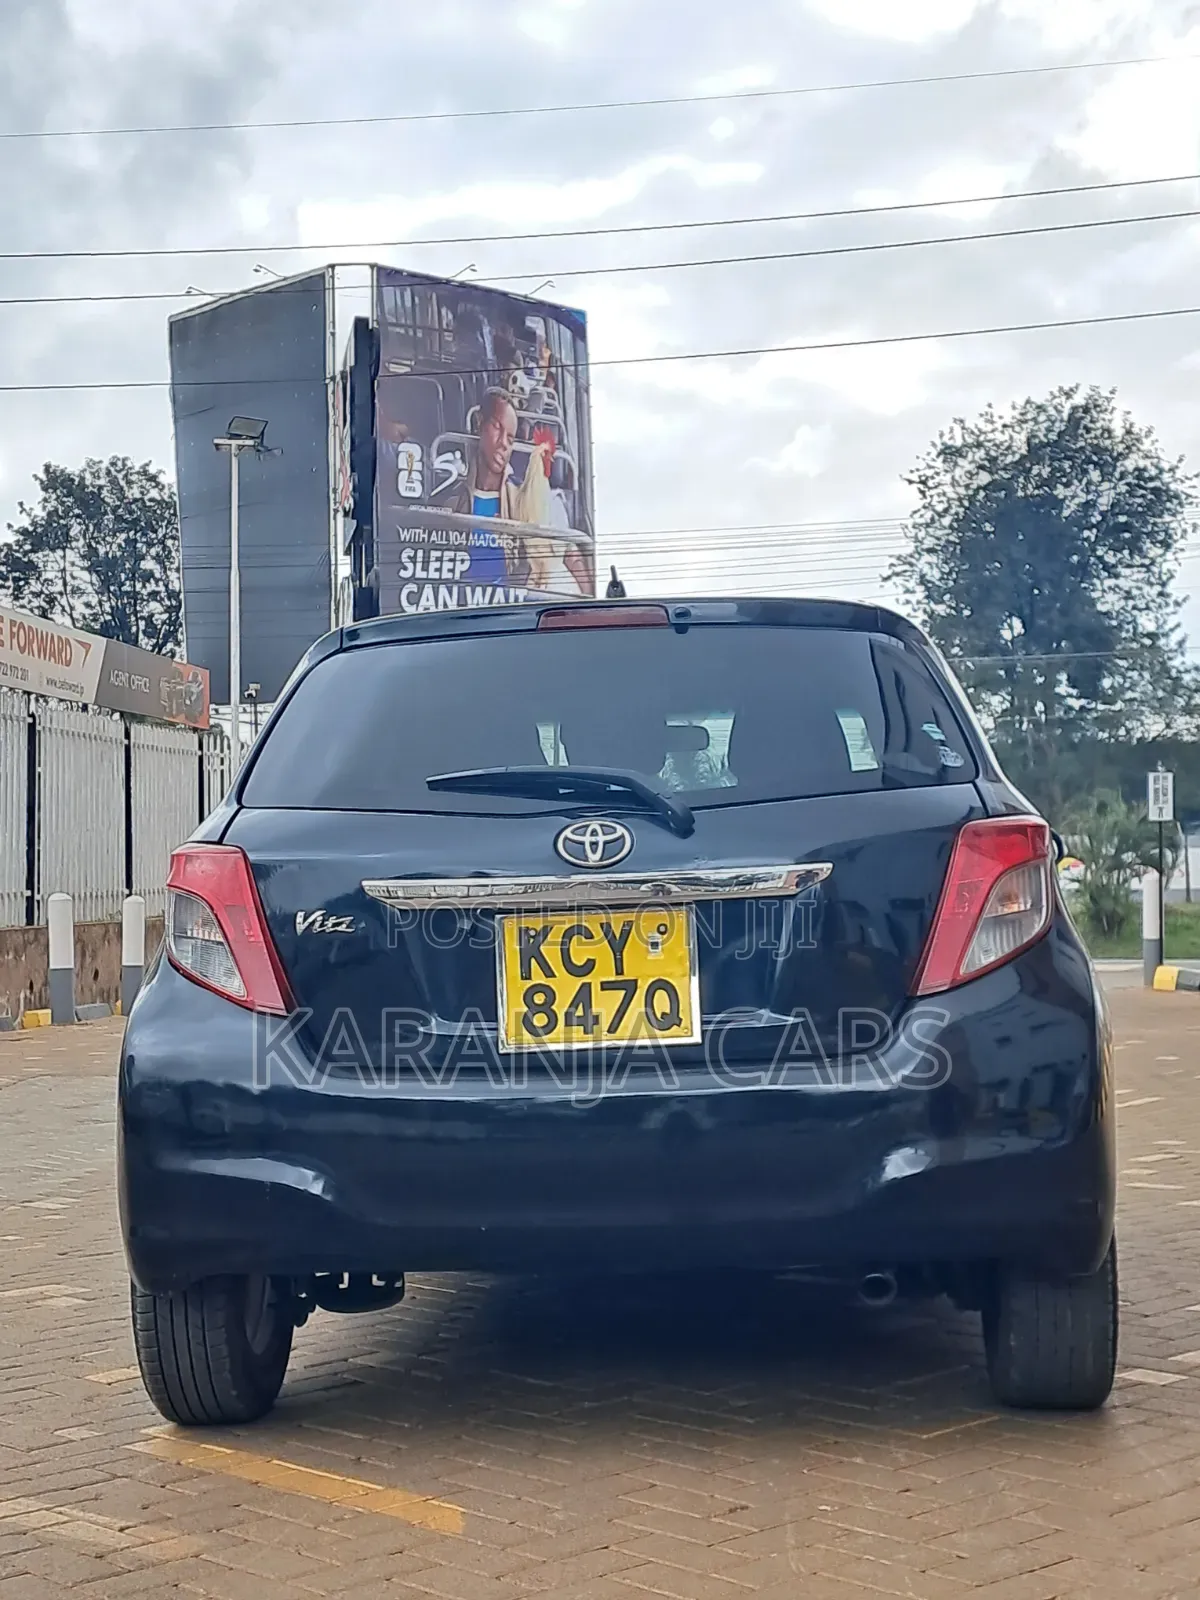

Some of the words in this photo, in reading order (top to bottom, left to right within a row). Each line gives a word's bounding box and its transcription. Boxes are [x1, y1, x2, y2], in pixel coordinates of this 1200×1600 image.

[396, 526, 428, 543] WITH
[429, 530, 449, 544] ALL
[449, 531, 467, 546] 104
[400, 548, 471, 580] SLEEP
[400, 582, 459, 613] CAN
[9, 618, 73, 668] FORWARD
[109, 669, 130, 688] AGENT
[130, 674, 150, 693] OFFICE
[295, 909, 356, 937] Vitz
[518, 919, 635, 981] KCY
[521, 977, 683, 1038] 847Q
